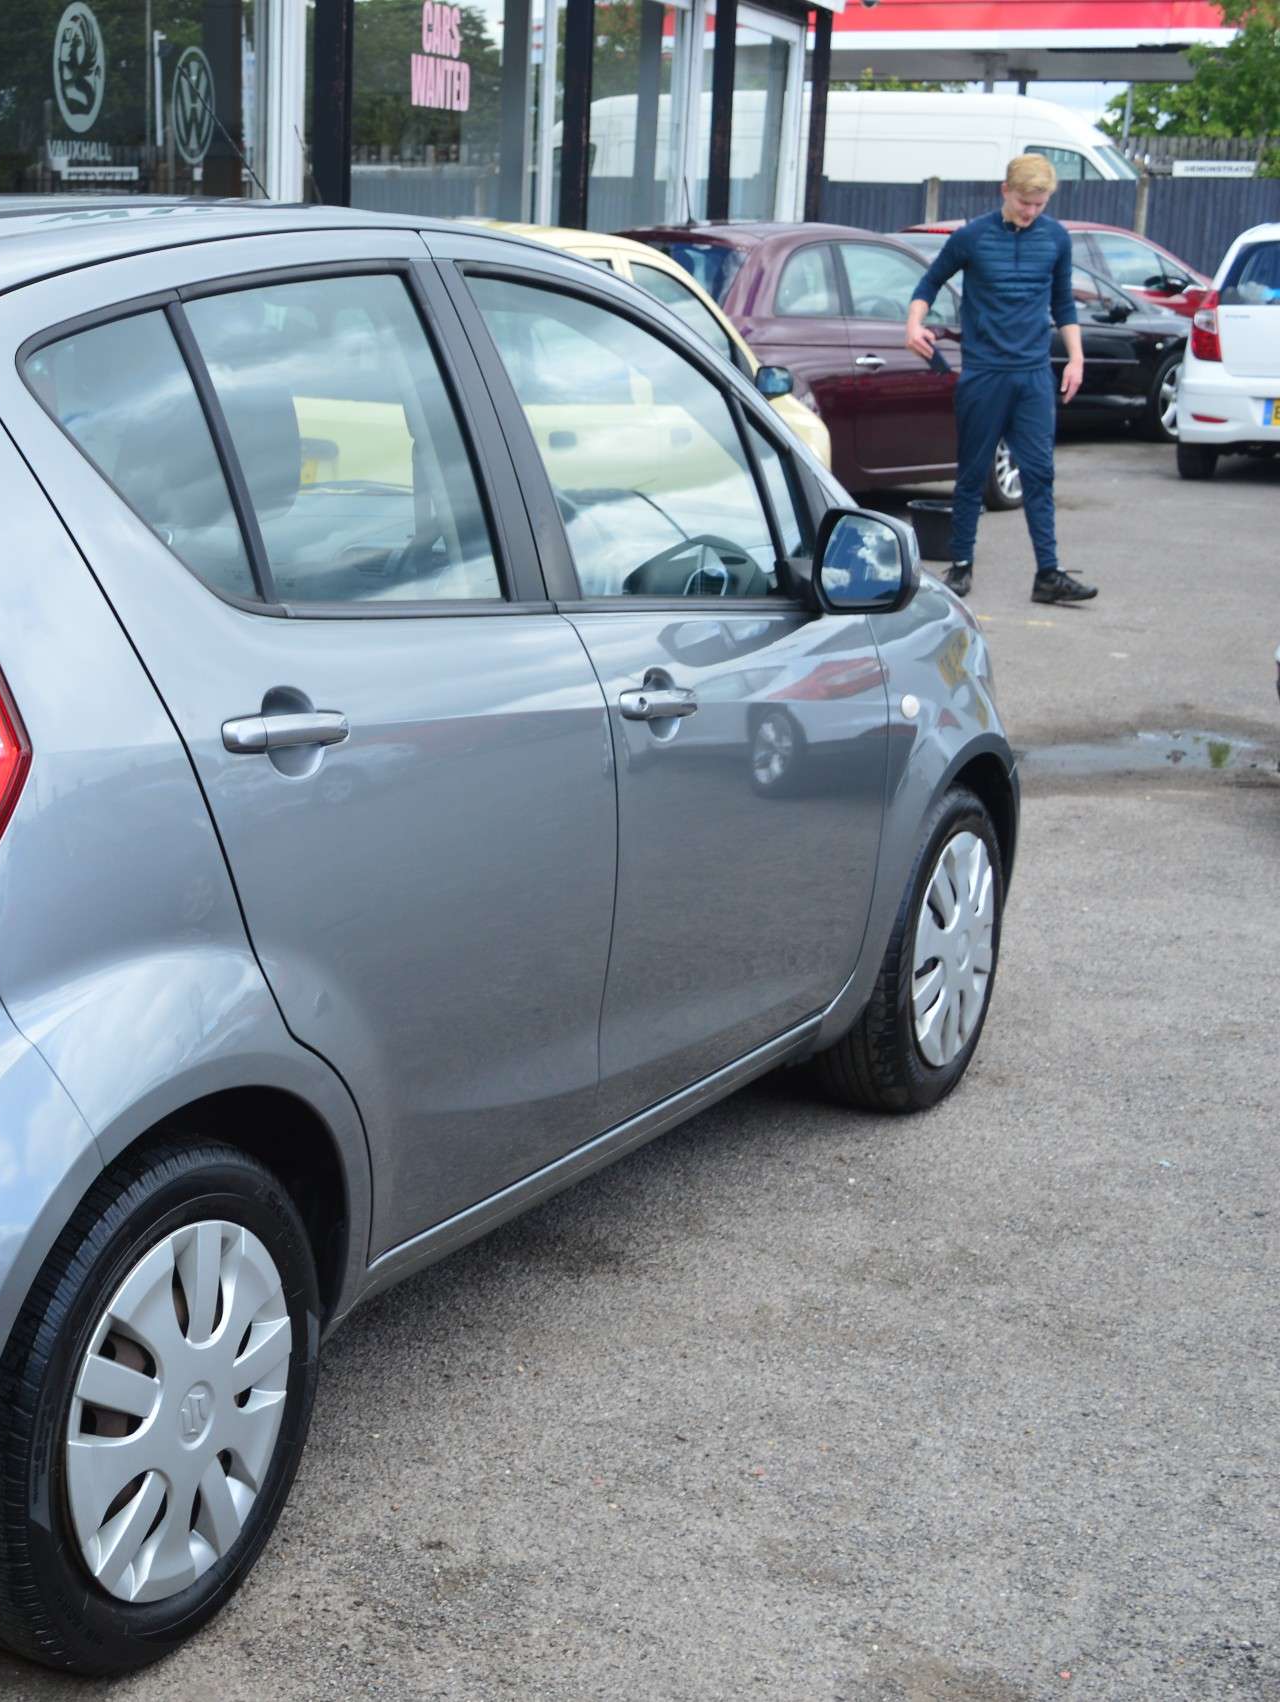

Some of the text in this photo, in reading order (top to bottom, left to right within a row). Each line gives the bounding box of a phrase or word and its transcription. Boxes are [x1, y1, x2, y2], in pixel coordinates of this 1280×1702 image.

[422, 1, 462, 58] CARS
[411, 53, 470, 111] WANTED
[47, 139, 112, 161] VAUXHALL
